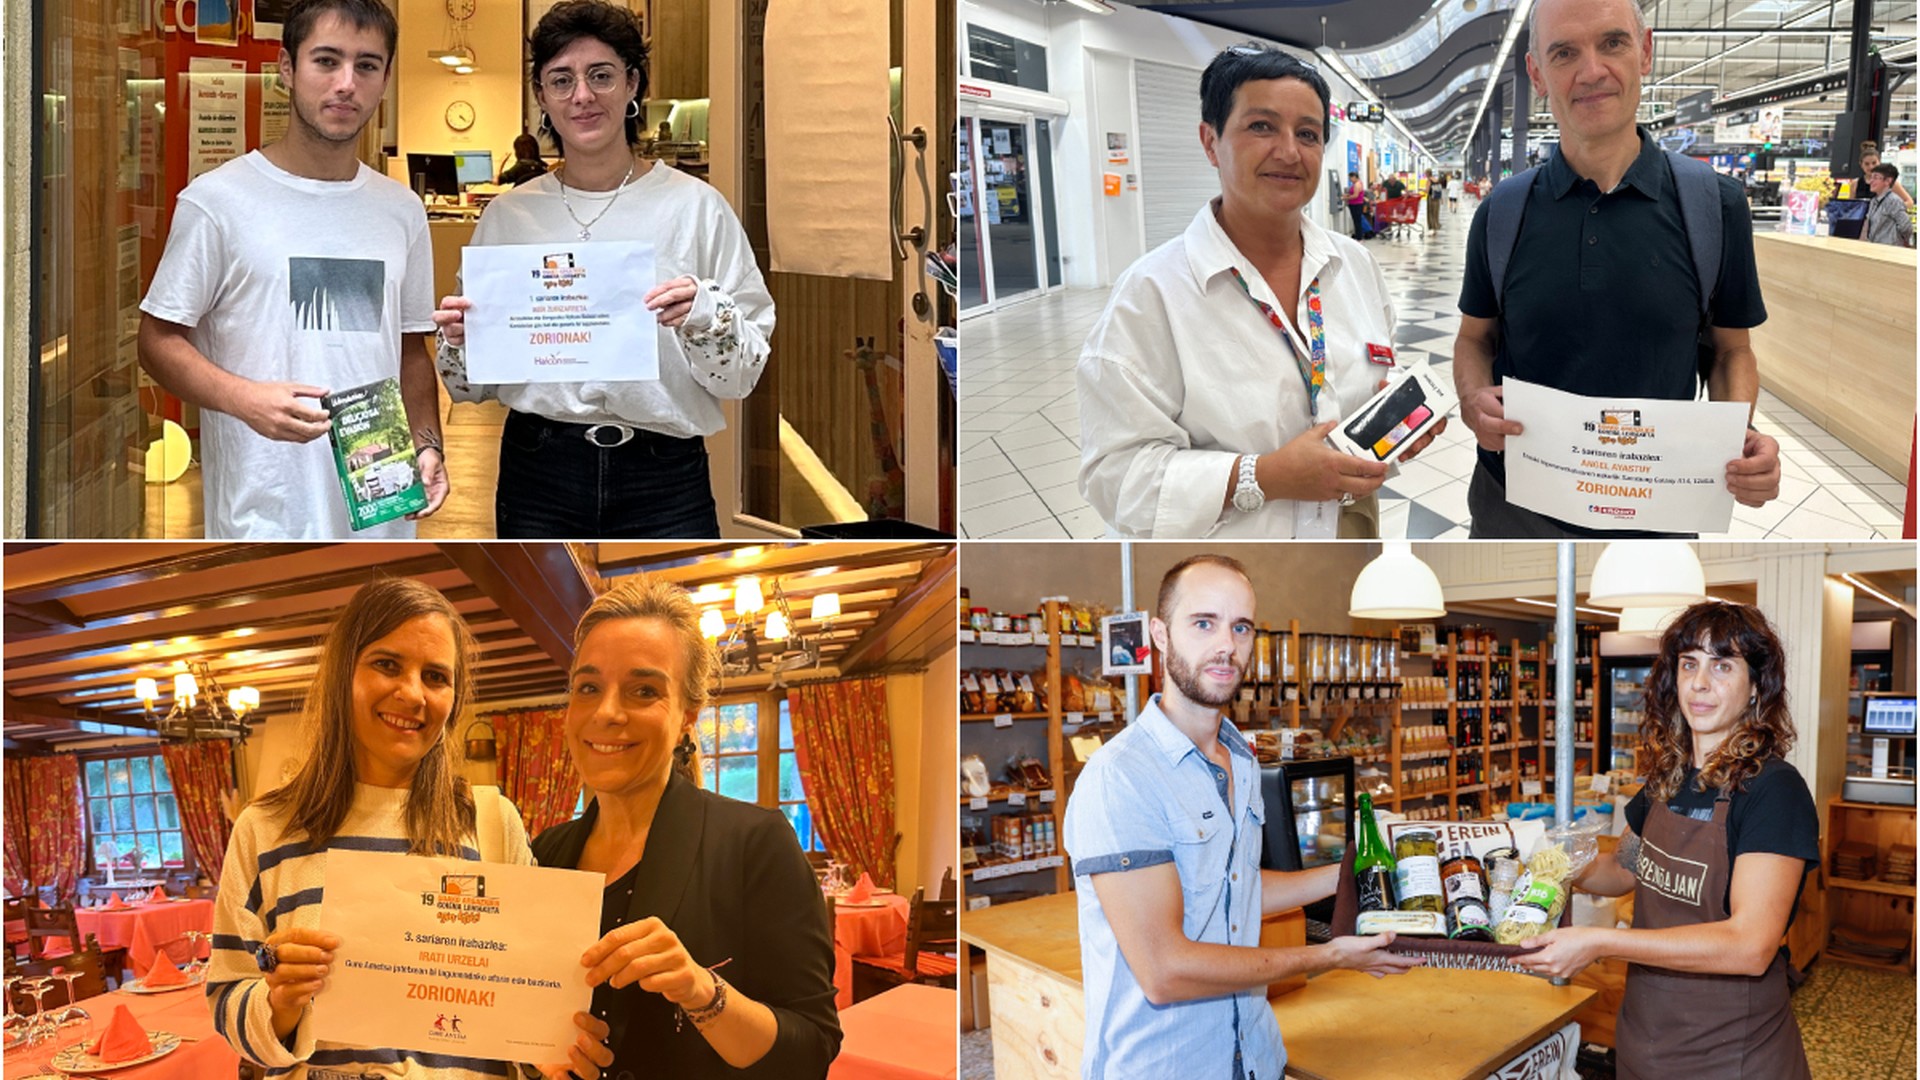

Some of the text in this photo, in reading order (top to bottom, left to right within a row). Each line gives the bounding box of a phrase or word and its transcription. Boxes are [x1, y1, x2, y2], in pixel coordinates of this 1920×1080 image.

[529, 331, 592, 345] ZORIONAK!
[1583, 421, 1596, 432] 19
[1572, 445, 1580, 454] 2.
[1581, 448, 1618, 458] sariaren
[1580, 459, 1652, 473] ANGEL AYASTUY
[1576, 480, 1653, 499] ZORIONAK!
[1447, 825, 1502, 842] EREIN
[1671, 873, 1699, 899] JAN
[420, 893, 435, 906] 19
[404, 931, 508, 951] 3. sariaren irabazlea:
[418, 951, 489, 968] IRATI URZELAI
[406, 982, 496, 1008] ZORIONAK!
[1531, 1040, 1561, 1076] EREIN
